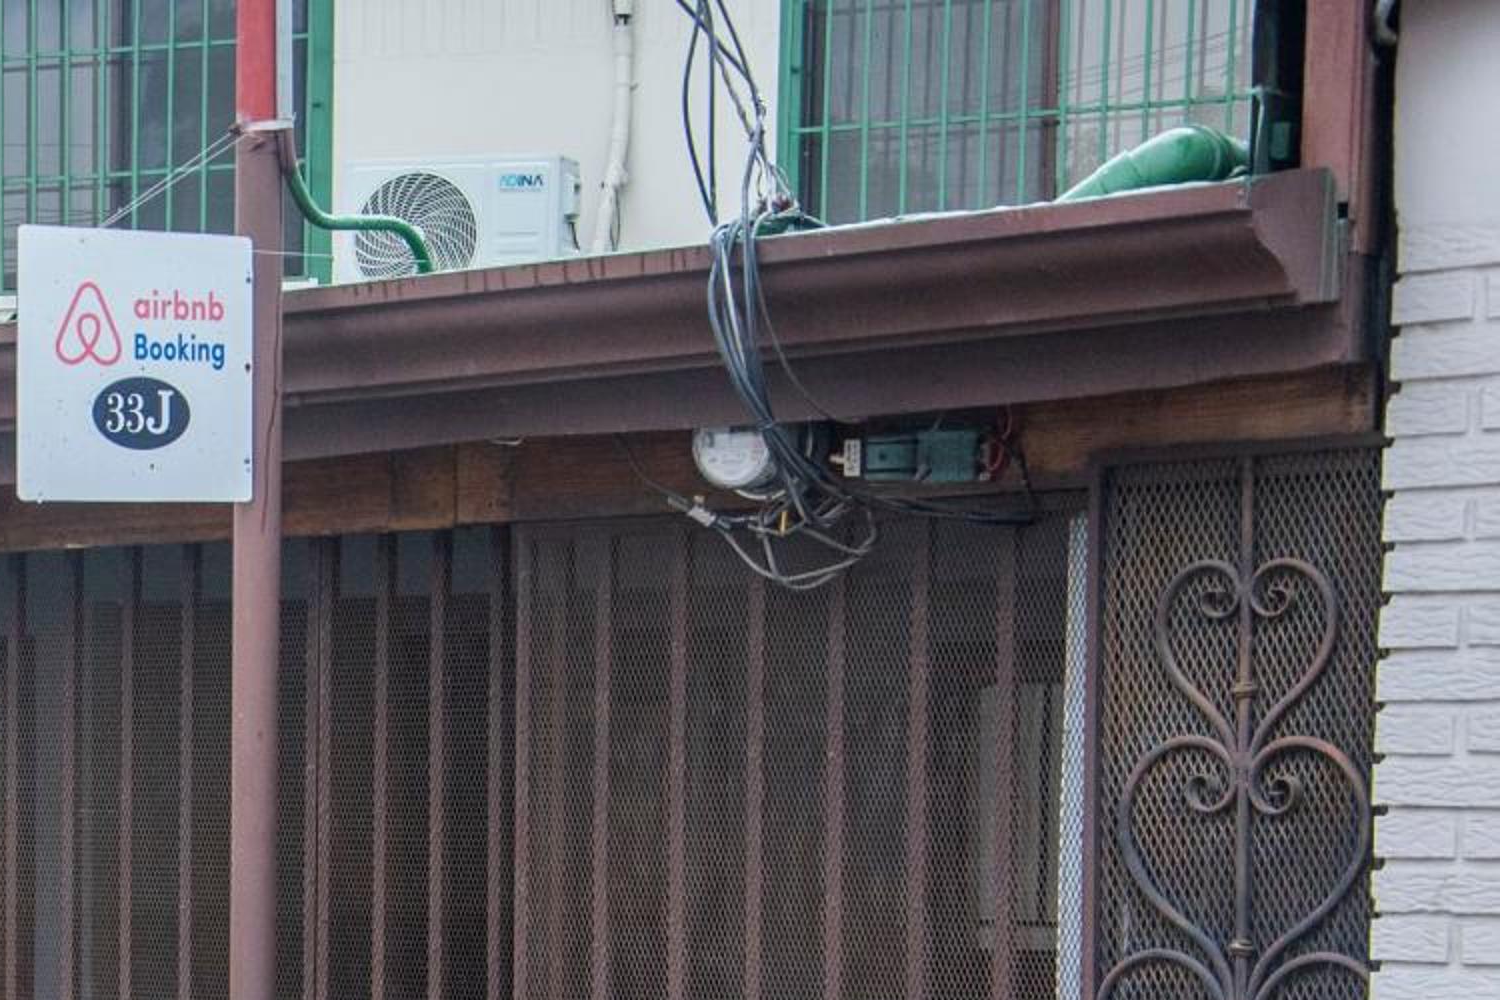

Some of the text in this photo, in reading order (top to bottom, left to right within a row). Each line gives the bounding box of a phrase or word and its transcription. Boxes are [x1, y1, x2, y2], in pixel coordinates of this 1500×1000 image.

[134, 290, 224, 321] airbnb
[134, 333, 225, 370] Booking
[106, 389, 174, 434] 33J
